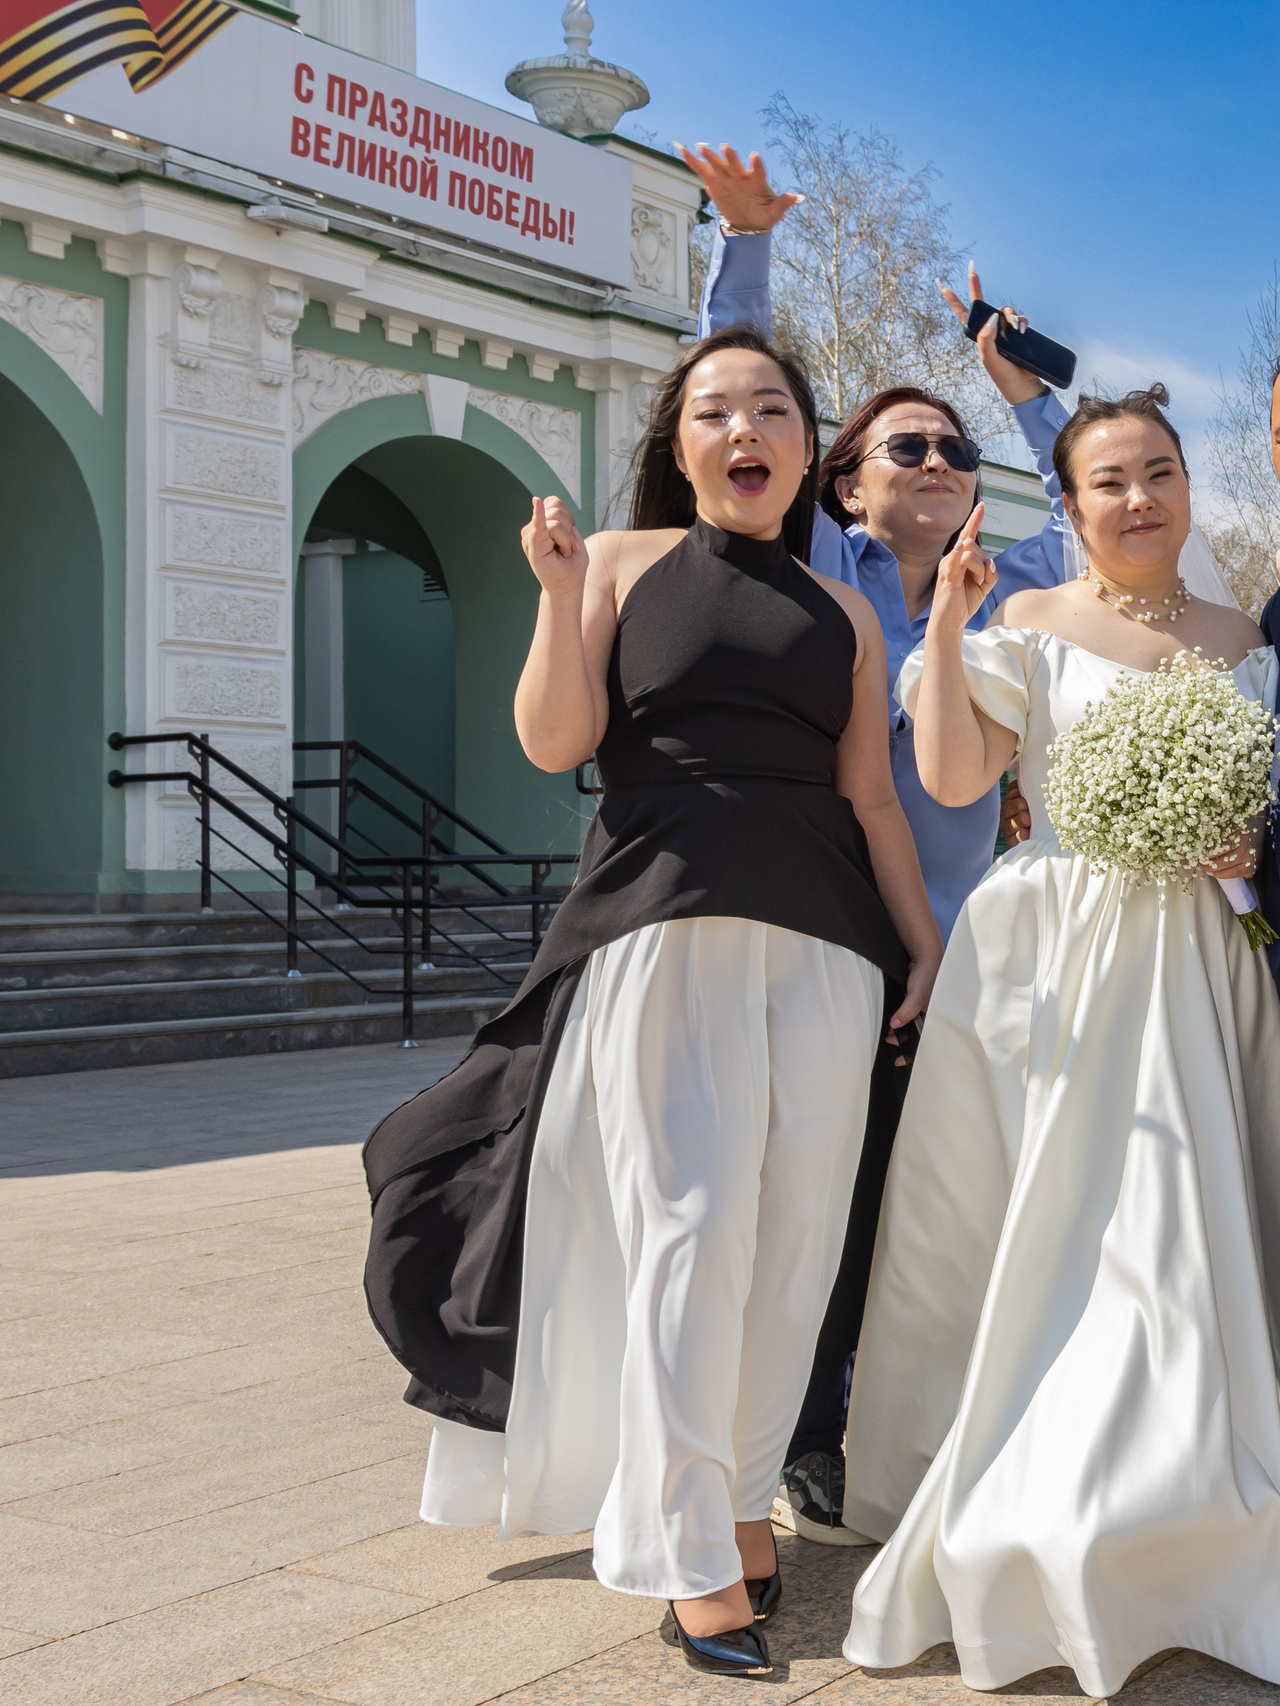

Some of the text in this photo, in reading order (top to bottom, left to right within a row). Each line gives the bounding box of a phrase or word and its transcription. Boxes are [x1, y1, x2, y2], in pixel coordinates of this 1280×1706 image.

[290, 115, 576, 246] ВЕЛИКОЙ ПОБЕДЫ!
[294, 62, 534, 183] С ПРАЗДНИКОМ
